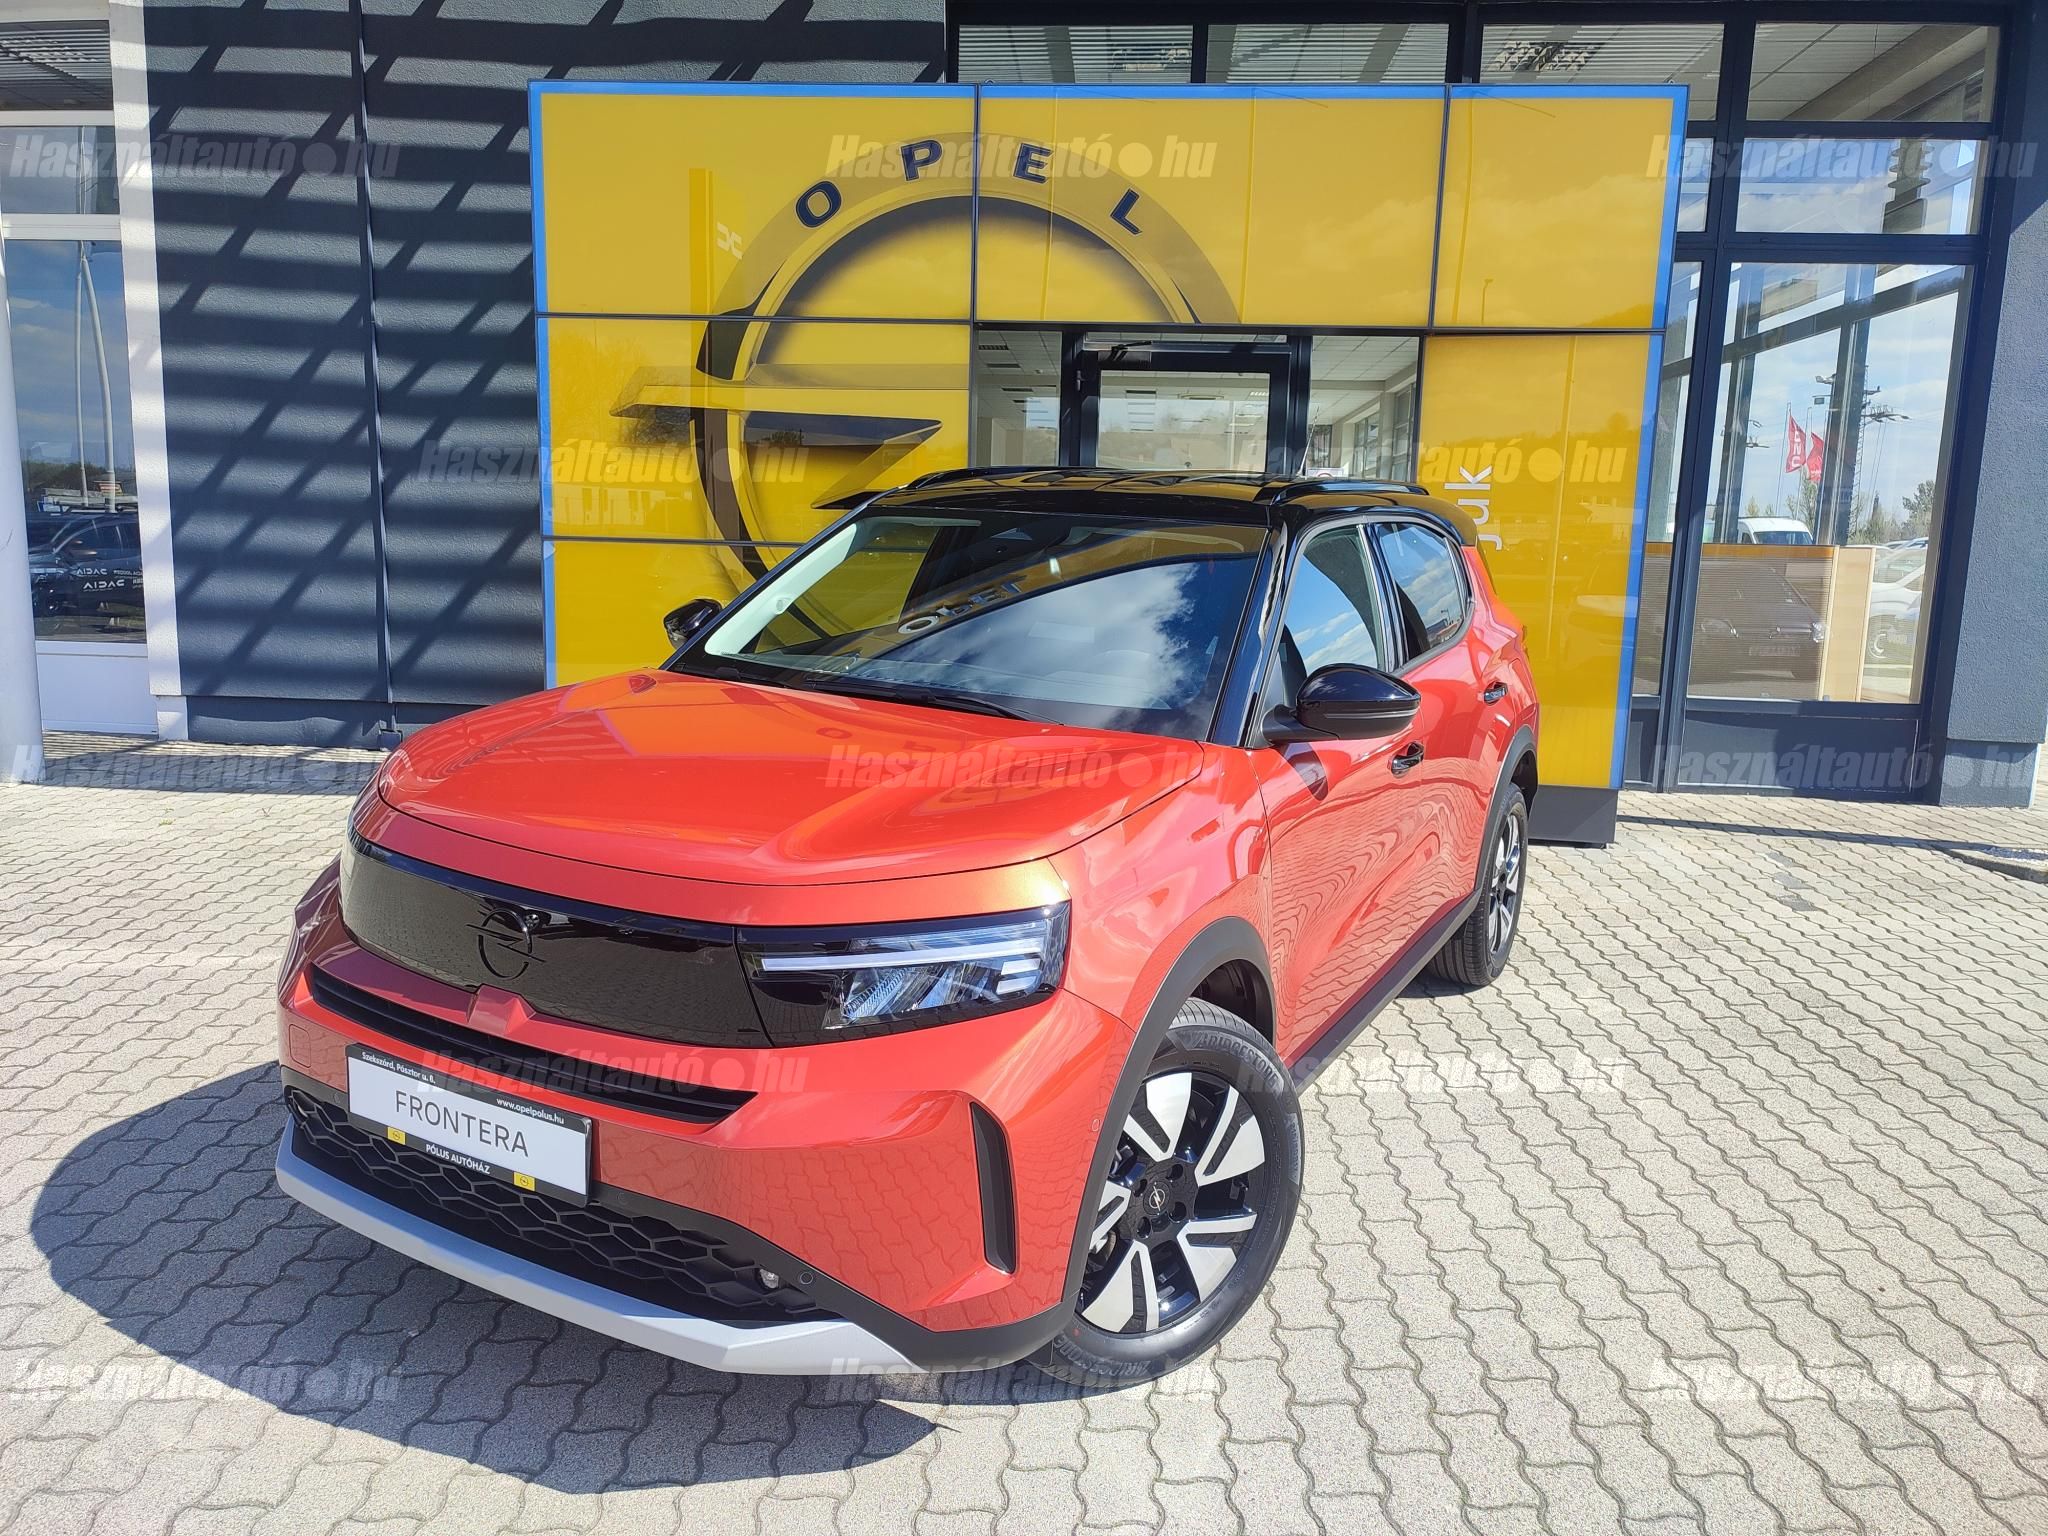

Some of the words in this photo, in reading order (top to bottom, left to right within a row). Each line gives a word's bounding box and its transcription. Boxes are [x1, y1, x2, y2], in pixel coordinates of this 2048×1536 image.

[795, 138, 1144, 236] OPEL
[395, 1090, 529, 1158] FRONTERA
[496, 1098, 565, 1125] www.opelpolus.hu
[425, 1143, 450, 1161] PÓLUS
[451, 1153, 491, 1175] AUTÓHÁZ
